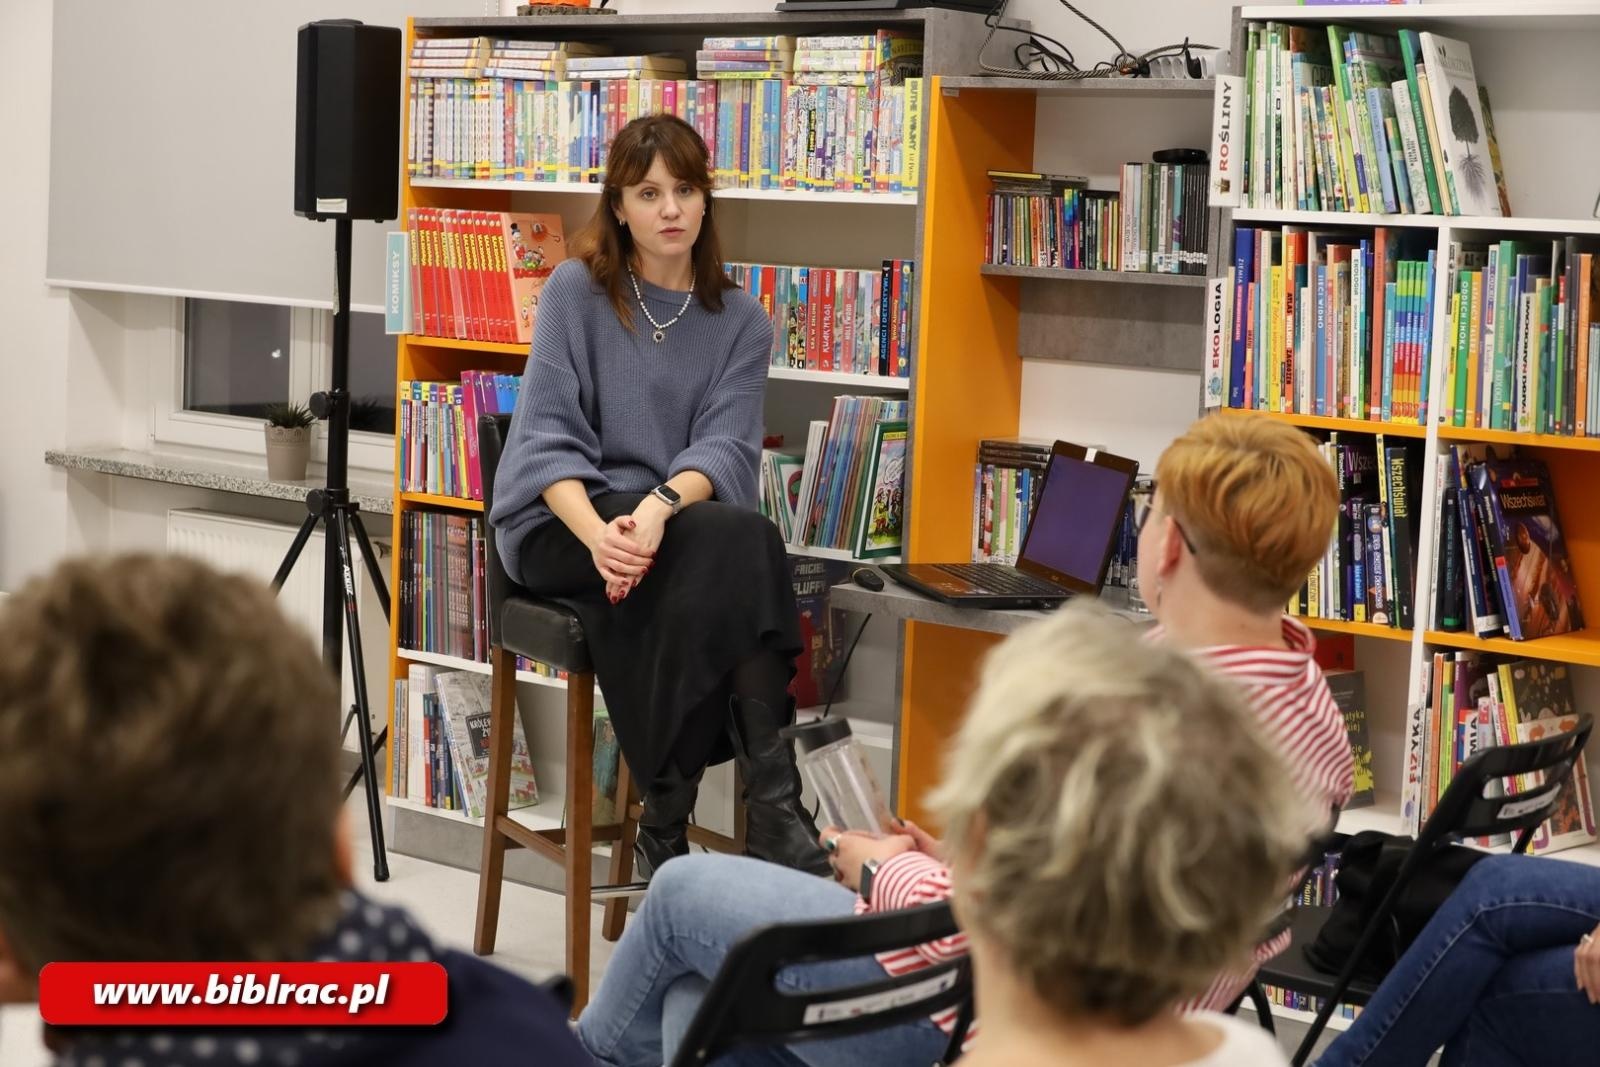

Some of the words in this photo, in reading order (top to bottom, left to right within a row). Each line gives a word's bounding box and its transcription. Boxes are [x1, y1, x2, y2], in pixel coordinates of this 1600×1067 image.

[1218, 82, 1232, 171] ROŚLINY
[391, 250, 401, 315] KOMIKSY
[882, 277, 890, 323] DETEKTYWI
[1237, 257, 1246, 284] ZIEMIA
[1461, 280, 1469, 319] ODDECH
[1211, 282, 1223, 369] EKOLOGIA
[1522, 295, 1531, 373] NARODOWE
[1493, 369, 1503, 406] EKOLOGIA
[1391, 457, 1408, 518] Wszechświat
[1409, 706, 1422, 783] FIZYKA
